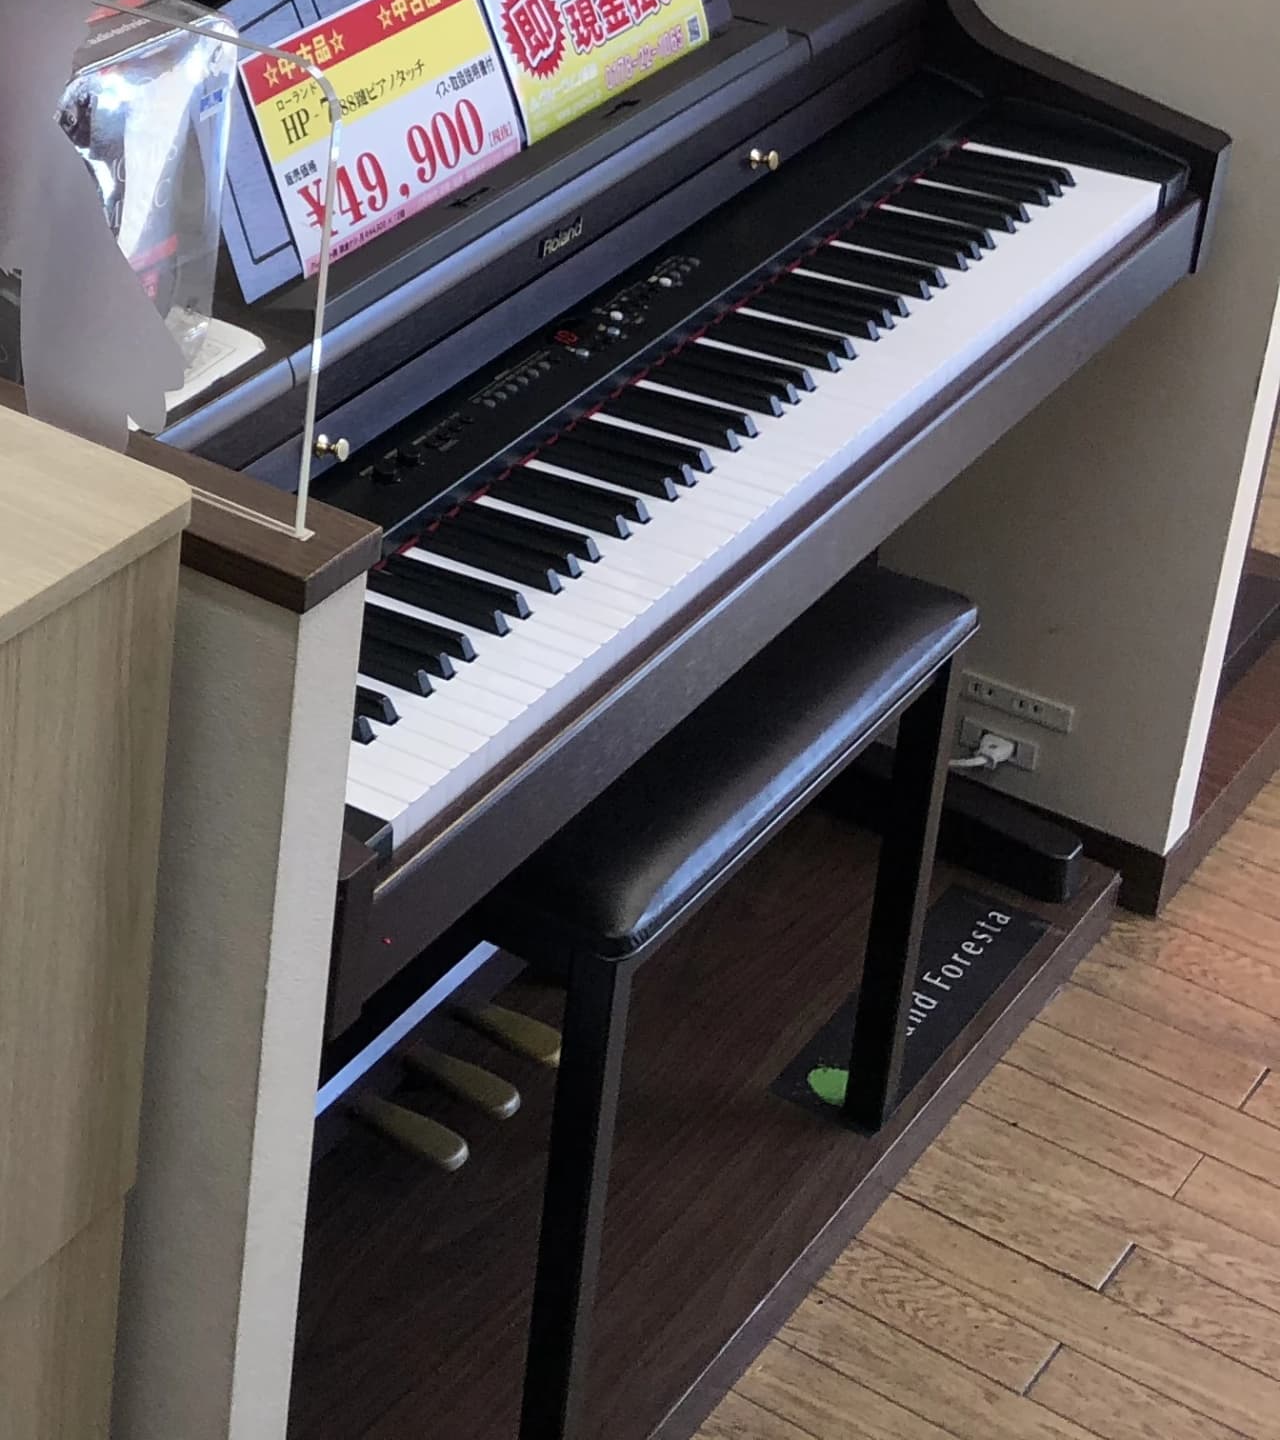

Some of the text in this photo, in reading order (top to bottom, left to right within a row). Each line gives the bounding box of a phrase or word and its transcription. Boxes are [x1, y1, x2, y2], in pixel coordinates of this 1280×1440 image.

[283, 159, 319, 187] 販売価格
[296, 97, 485, 239] ¥49,900
[542, 218, 584, 259] Roland
[921, 909, 1012, 992] Foresta
